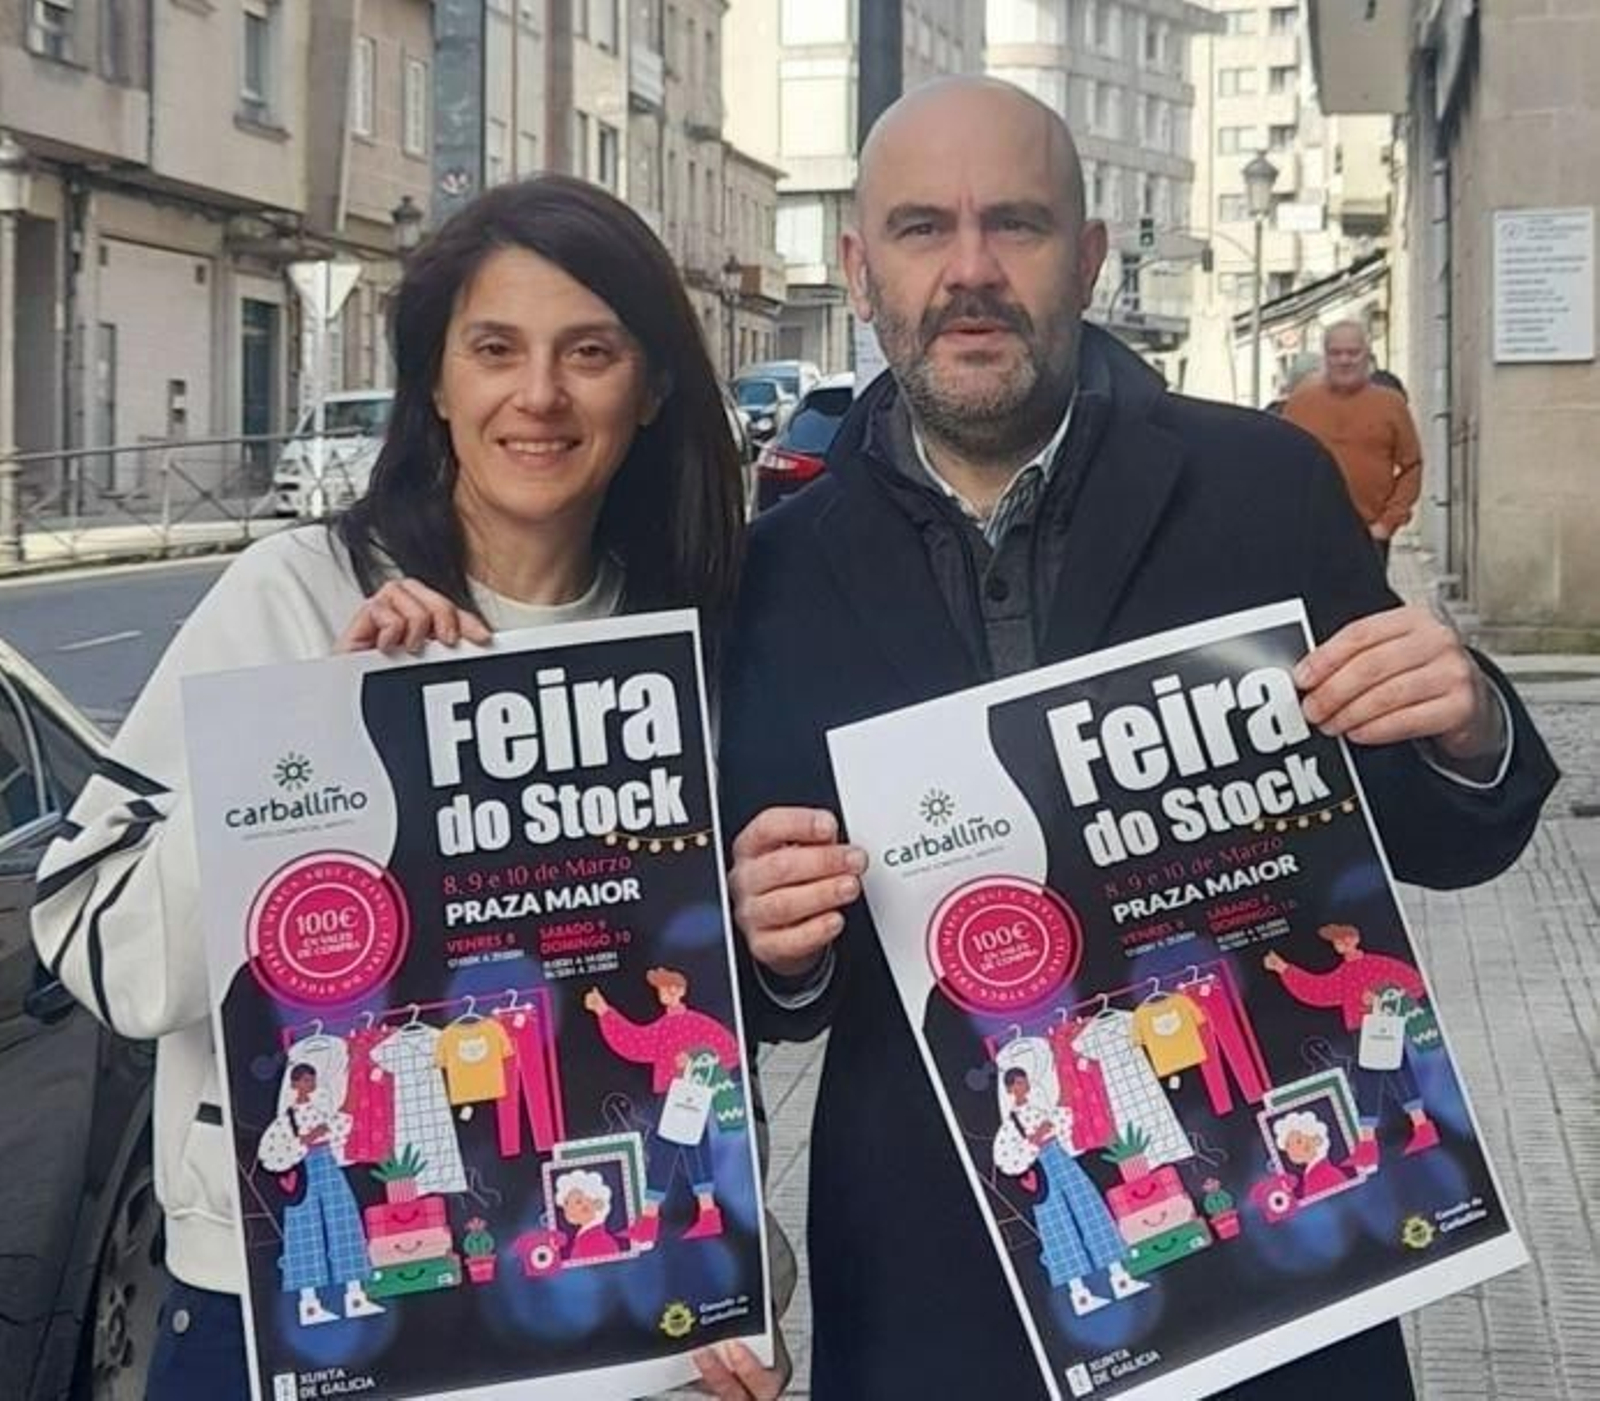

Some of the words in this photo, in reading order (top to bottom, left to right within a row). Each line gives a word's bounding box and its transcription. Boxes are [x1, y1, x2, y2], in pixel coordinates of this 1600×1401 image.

[422, 667, 682, 788] Feira
[1047, 667, 1310, 806] Feira
[437, 794, 511, 856] do
[521, 767, 688, 844] Stock
[1084, 809, 1159, 867] do
[1162, 753, 1331, 842] Stock
[469, 873, 483, 888] 9
[489, 875, 500, 885] e
[507, 865, 528, 885] 10
[535, 862, 559, 880] de
[566, 856, 631, 877] Marzo
[1191, 857, 1214, 875] de
[1219, 838, 1283, 864] Marzo
[446, 892, 541, 926] PRAZA
[547, 878, 640, 912] MAIOR
[1112, 884, 1204, 924] PRAZA
[1205, 854, 1299, 896] MAIOR
[295, 906, 358, 936] 100€
[972, 921, 1031, 953] 100€
[541, 935, 610, 954] DOMINGO
[300, 1368, 345, 1384] XUNTA
[1089, 1349, 1130, 1370] XUNTA
[1093, 1370, 1110, 1385] DE
[1111, 1351, 1160, 1377] GALICIA
[301, 1386, 317, 1398] DE
[321, 1377, 375, 1395] GALICIA
